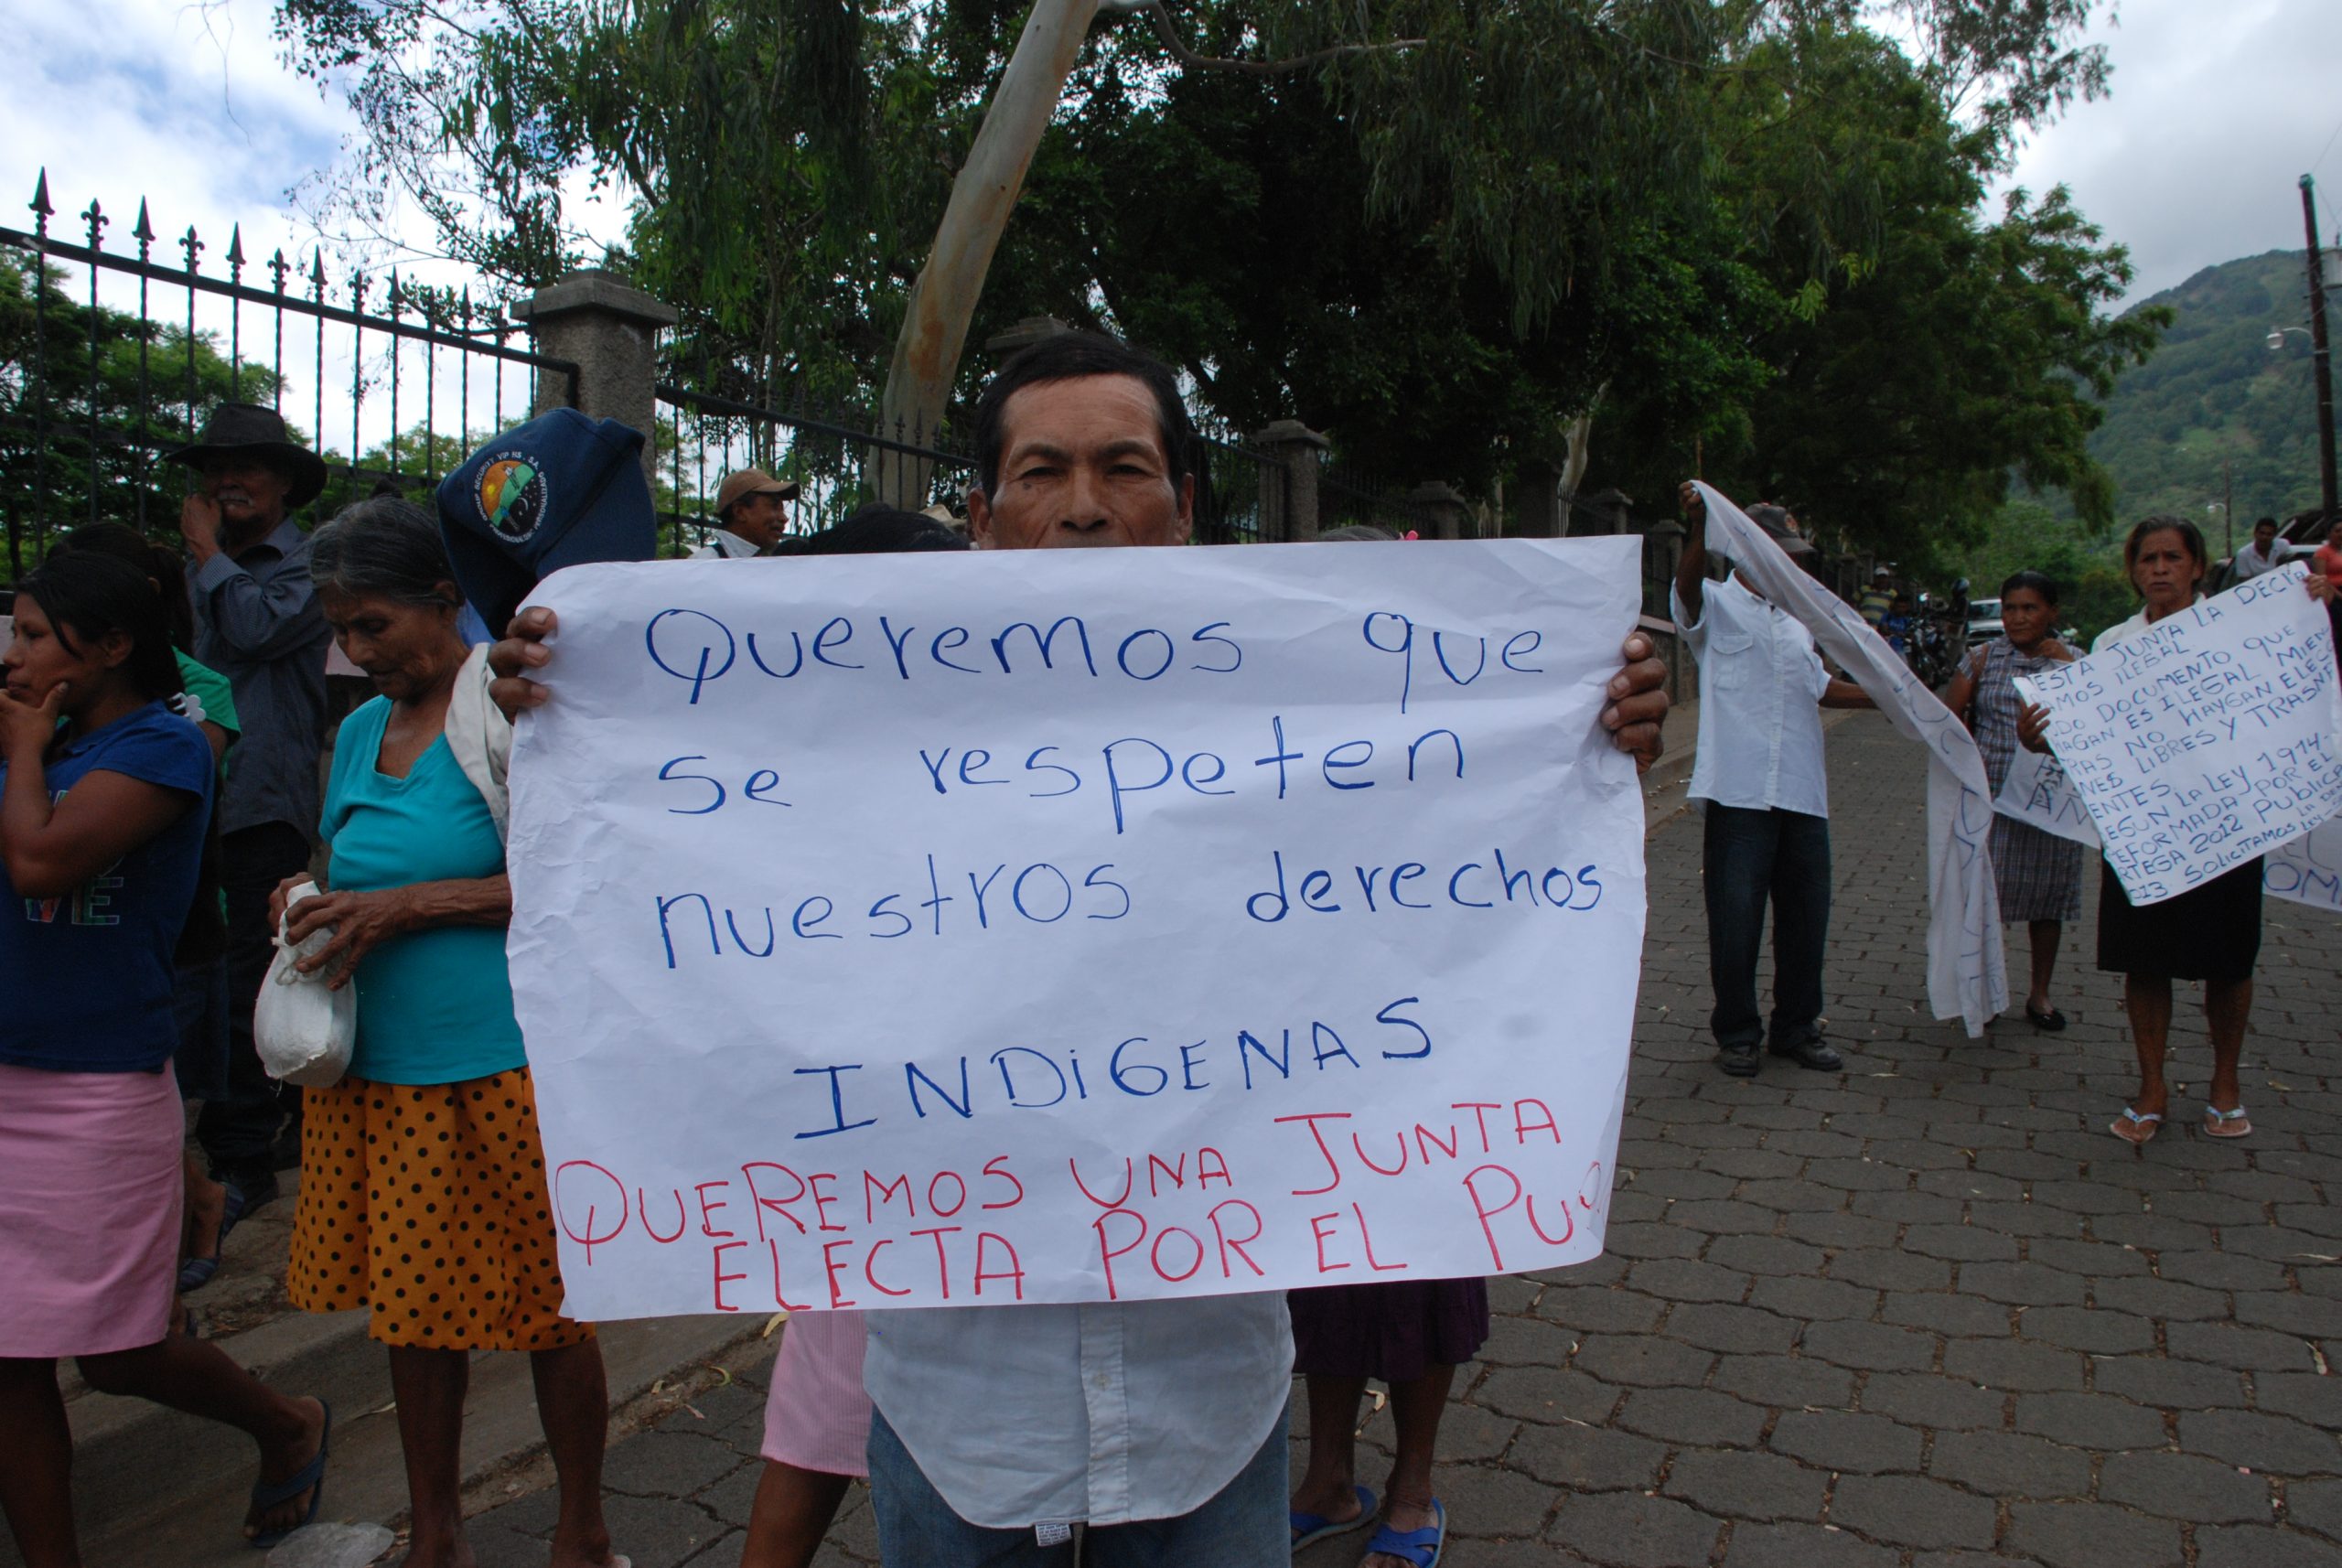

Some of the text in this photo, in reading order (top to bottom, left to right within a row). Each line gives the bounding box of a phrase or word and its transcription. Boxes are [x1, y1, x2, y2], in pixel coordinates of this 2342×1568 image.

[474, 457, 494, 490] SECURITY
[497, 451, 510, 460] VIP
[645, 608, 1544, 714] Queremos que
[2034, 660, 2095, 692] ESTA
[2106, 624, 2185, 671] JUNTA
[2191, 607, 2223, 628] LA
[2096, 650, 2231, 723] DOCUMENTO
[2124, 731, 2165, 757] NO
[2177, 682, 2273, 727] HAYGAN
[2126, 708, 2154, 730] ES
[2159, 663, 2261, 712] ILEGAL
[919, 715, 1464, 835] respeten
[2135, 729, 2217, 774] LIBRES
[2218, 716, 2236, 741] Y
[2254, 767, 2302, 797] POR
[2307, 752, 2333, 772] EL
[2089, 778, 2172, 820] ENTES
[2105, 804, 2170, 841] EGUN
[2175, 789, 2203, 807] LA
[2202, 765, 2251, 796] LEY
[2118, 849, 2186, 881] RTEGA
[2188, 813, 2243, 854] 2012
[656, 847, 1603, 970] nuestros derechos
[554, 1097, 1563, 1267] QUEREMOS UNA JUNTA
[713, 1226, 1026, 1312] ELECTA
[1092, 1198, 1266, 1301] POR
[1309, 1201, 1409, 1274] EL
